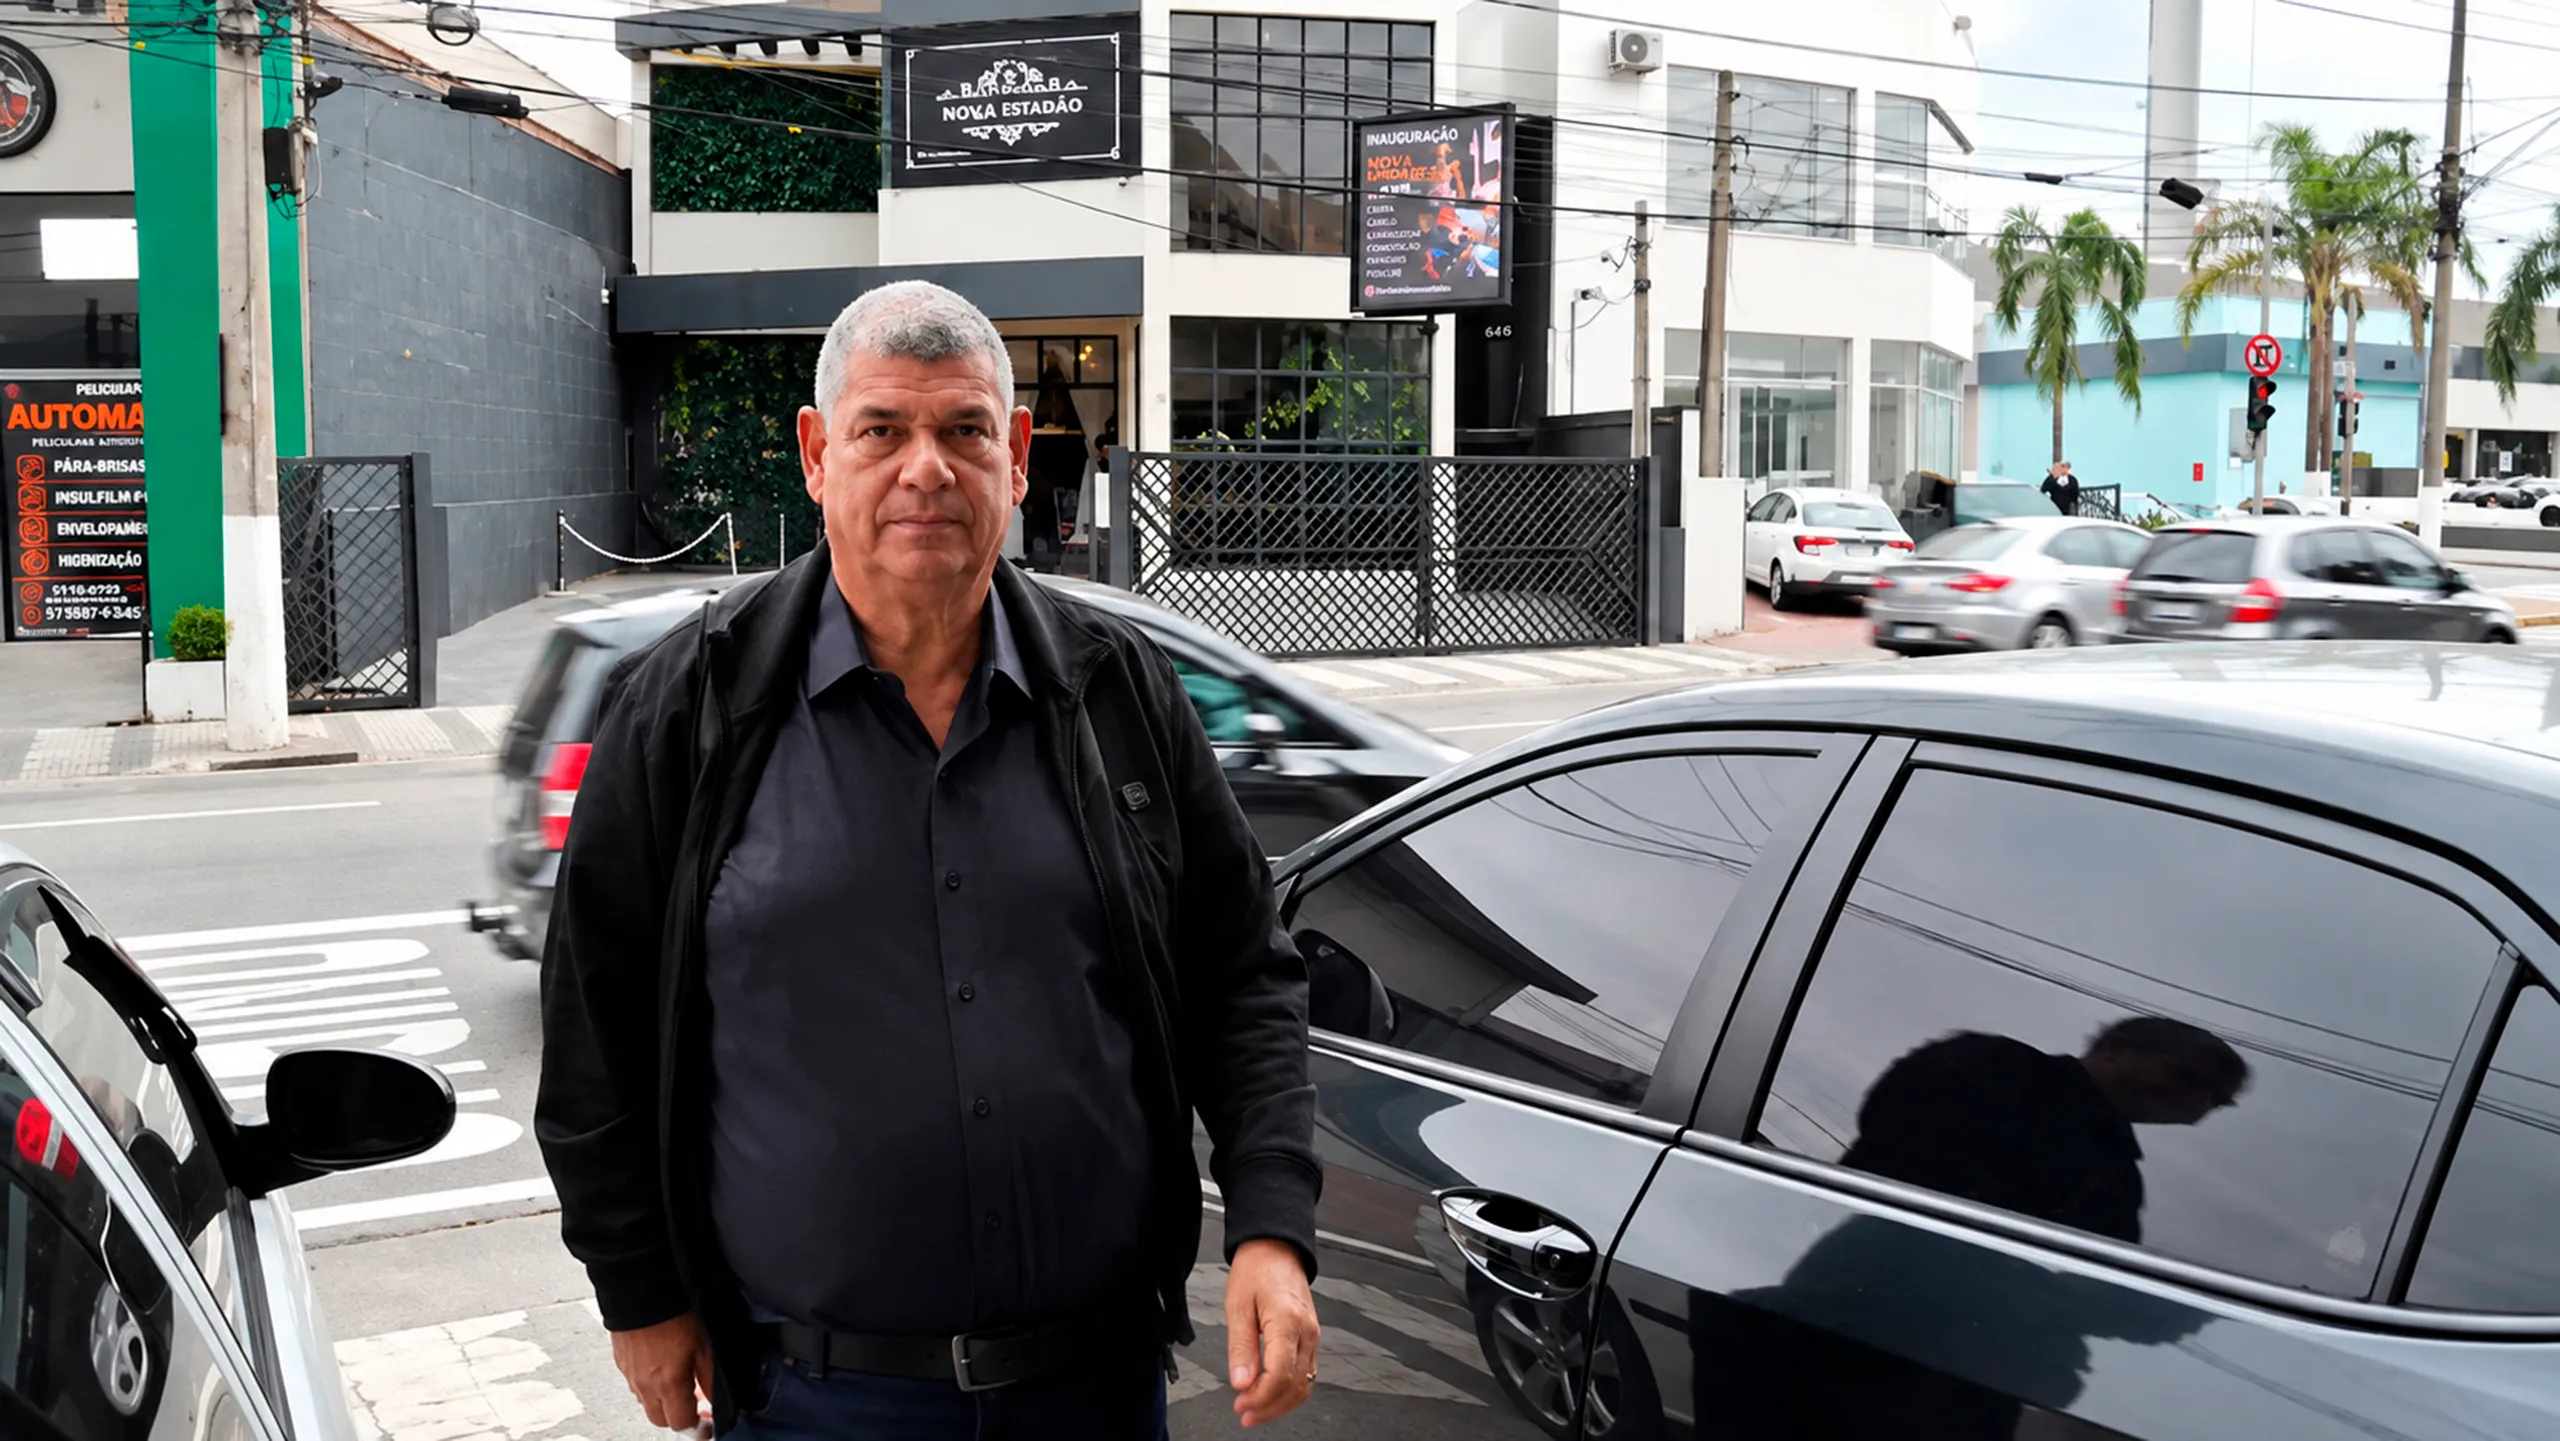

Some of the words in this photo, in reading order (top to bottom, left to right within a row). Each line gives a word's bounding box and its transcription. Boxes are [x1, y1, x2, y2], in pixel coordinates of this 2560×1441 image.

[942, 103, 997, 121] NOVA
[1367, 154, 1412, 169] NOVA
[1485, 325, 1512, 338] 646
[55, 490, 131, 504] INSULFILM
